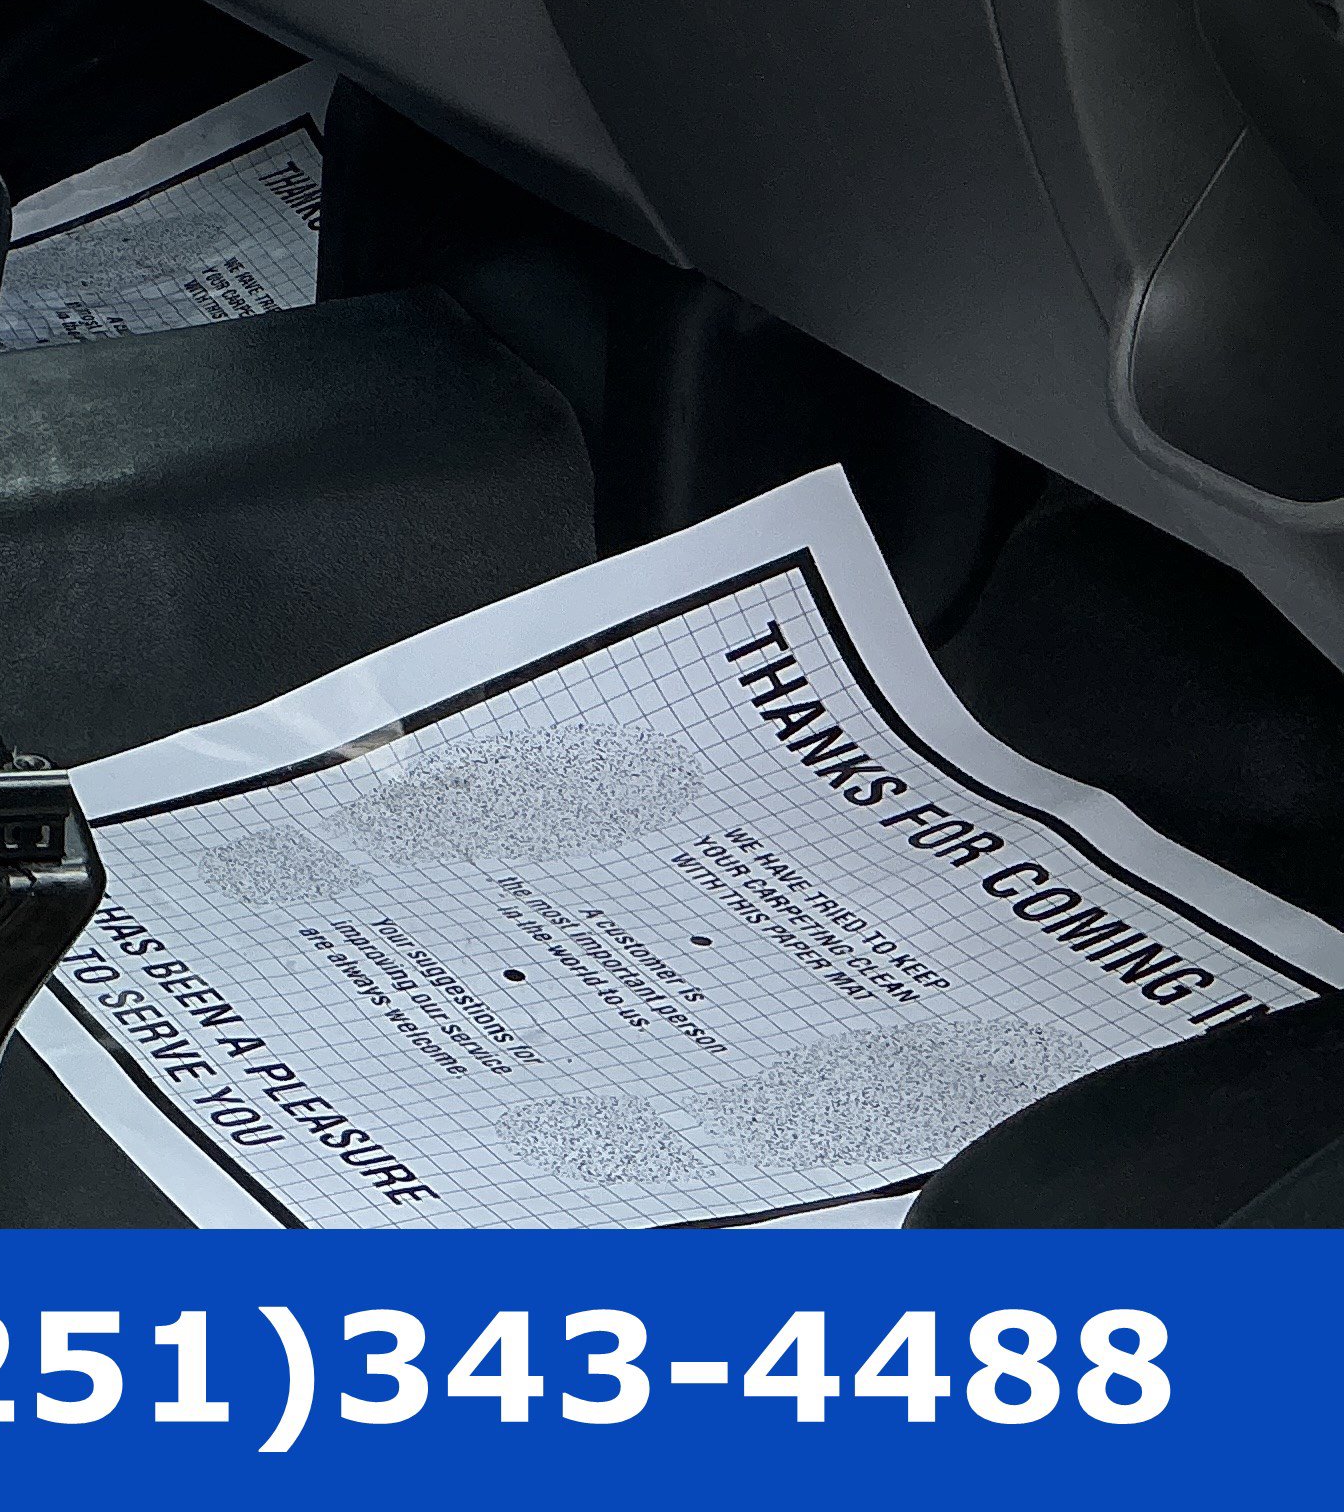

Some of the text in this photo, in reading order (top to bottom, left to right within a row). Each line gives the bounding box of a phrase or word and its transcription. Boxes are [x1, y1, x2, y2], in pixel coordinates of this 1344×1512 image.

[724, 619, 908, 806] THANKS
[878, 803, 1005, 868] FOR
[982, 862, 1215, 1006] COMING
[497, 876, 729, 1055] the most important person
[497, 905, 651, 1033] in the world to us.
[577, 908, 705, 1003] A customer is
[671, 852, 879, 1002] WITH THIS PAPER MAT
[694, 835, 921, 1004] YOUR CARPETING CLEAN
[724, 828, 951, 991] WE HAVE TRIED TO KEEP
[62, 947, 286, 1146] TO SERVE YOU
[93, 905, 441, 1206] HAS BEEN A PLEASURE
[299, 927, 469, 1079] are always welcome.
[330, 919, 513, 1076] improving our service
[372, 916, 545, 1065] Your suggestions for
